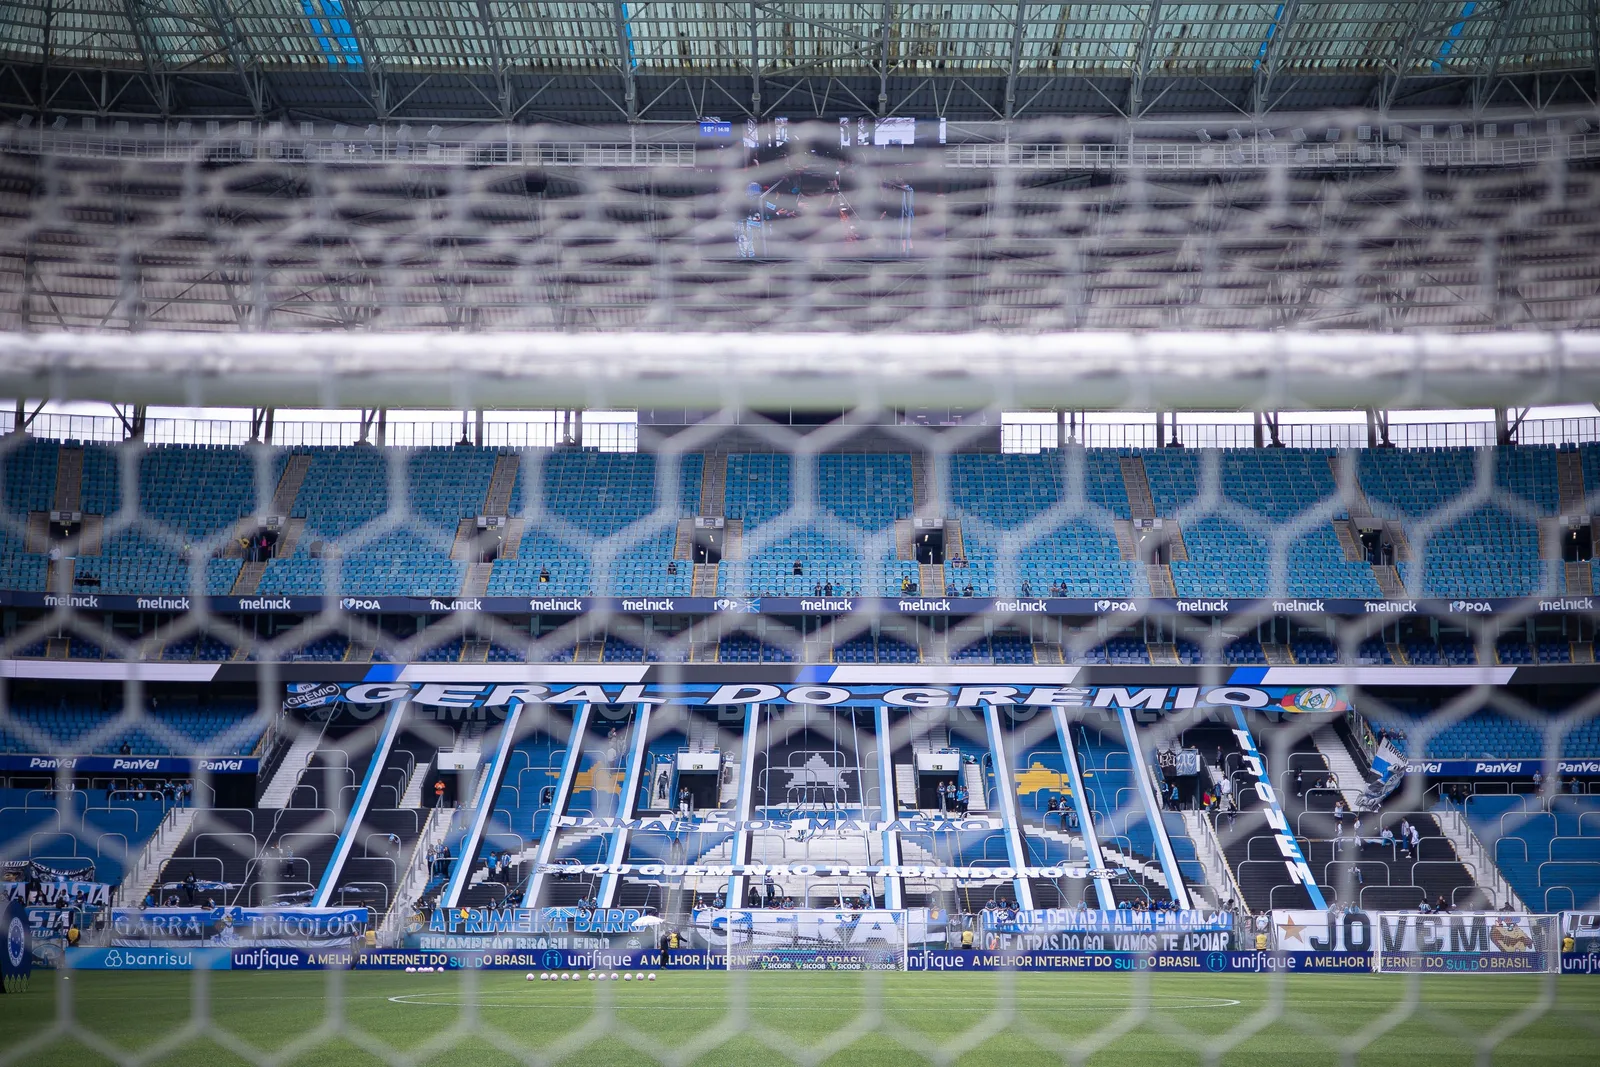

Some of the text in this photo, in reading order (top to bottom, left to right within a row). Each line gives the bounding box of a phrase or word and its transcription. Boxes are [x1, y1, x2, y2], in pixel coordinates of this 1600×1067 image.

[44, 595, 98, 607] melnick
[137, 597, 190, 609] melnick
[239, 598, 291, 610] melnick
[355, 600, 381, 610] POA
[530, 599, 582, 611] melnick
[622, 599, 675, 611] melnick
[801, 599, 853, 611] melnick
[899, 600, 951, 612] melnick
[995, 600, 1048, 612] melnick
[1111, 602, 1138, 612] POA
[1176, 600, 1229, 612] melnick
[1273, 600, 1325, 612] melnick
[1364, 600, 1417, 612] melnick
[1465, 602, 1493, 612] POA
[1539, 598, 1593, 611] melnick
[345, 684, 668, 708] GERAL
[706, 685, 851, 706] DO
[30, 757, 78, 771] PanVel
[113, 759, 160, 771] PanVel
[198, 759, 243, 771] PanVel
[1405, 763, 1442, 774] anVel
[1475, 763, 1523, 774] PanVel
[562, 817, 700, 831] JAMAIS
[717, 820, 793, 831] NOS
[639, 865, 734, 876] QUEM
[114, 914, 359, 938] GARRA TRICOLOR
[1016, 910, 1045, 932] QUE
[1046, 910, 1097, 931] DEIXAR
[1110, 910, 1153, 931] ALMA
[1155, 910, 1178, 931] EM
[1310, 910, 1490, 952] JOVEM
[1112, 933, 1159, 951] VAMOS
[1160, 933, 1179, 951] TE
[1183, 932, 1229, 951] APOIAR
[125, 952, 192, 966] banrisul
[234, 948, 299, 970] unifique
[307, 955, 316, 965] A
[370, 955, 428, 966] INTERNET
[429, 955, 448, 966] DO
[449, 957, 473, 968] SUL
[494, 955, 536, 966] BRASIL
[567, 949, 632, 971] unifique
[640, 955, 649, 966] A
[972, 956, 981, 967] A
[982, 956, 1033, 967] MELHOR
[1034, 956, 1093, 967] INTERNET
[1094, 956, 1112, 968] DO
[1114, 958, 1138, 970] SUL
[1159, 956, 1201, 968] BRASIL
[1232, 951, 1297, 972] unifique
[1304, 956, 1313, 967] A
[1315, 956, 1364, 967] MELHOR
[1426, 957, 1444, 968] DO
[1490, 957, 1533, 969] BRASIL
